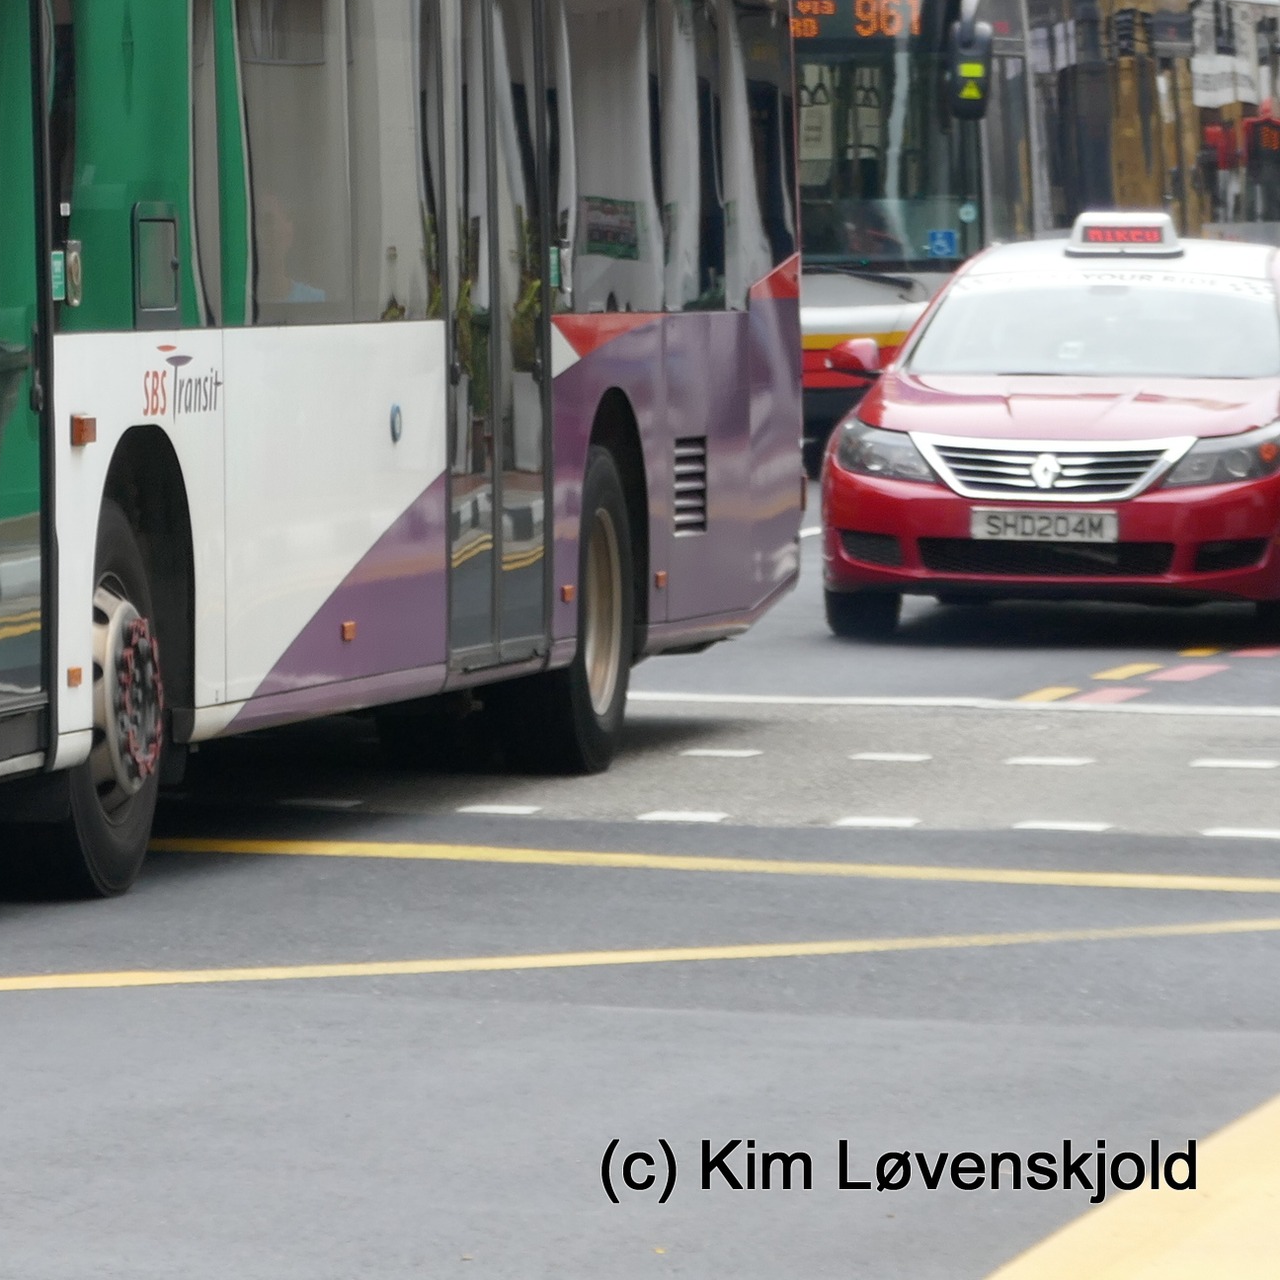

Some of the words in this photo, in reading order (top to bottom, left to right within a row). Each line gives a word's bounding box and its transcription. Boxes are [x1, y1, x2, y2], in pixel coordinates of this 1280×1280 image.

[142, 369, 168, 417] SBS
[165, 355, 223, 424] Transit
[986, 514, 1104, 538] SHD204M
